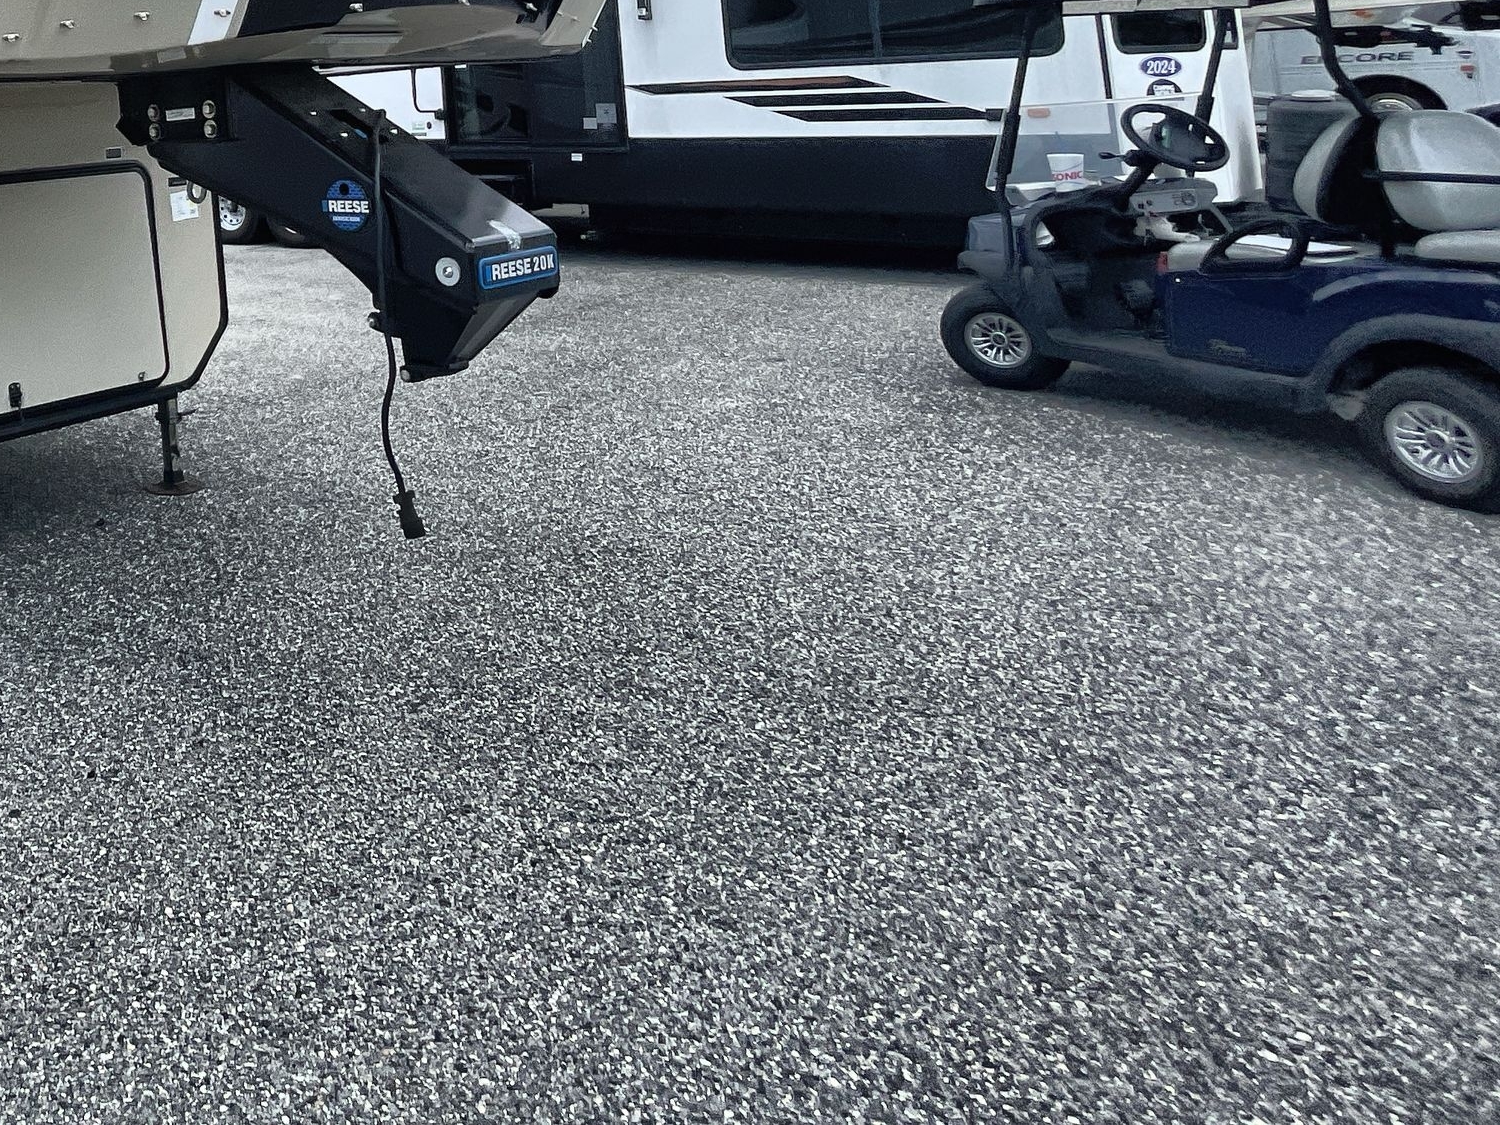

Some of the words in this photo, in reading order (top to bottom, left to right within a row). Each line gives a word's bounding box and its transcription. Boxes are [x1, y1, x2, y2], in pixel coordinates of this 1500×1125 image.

[1300, 51, 1415, 66] ECORE
[1146, 59, 1177, 74] 2024
[328, 200, 370, 214] REESE
[491, 258, 532, 281] REESE
[533, 254, 555, 272] 20K
